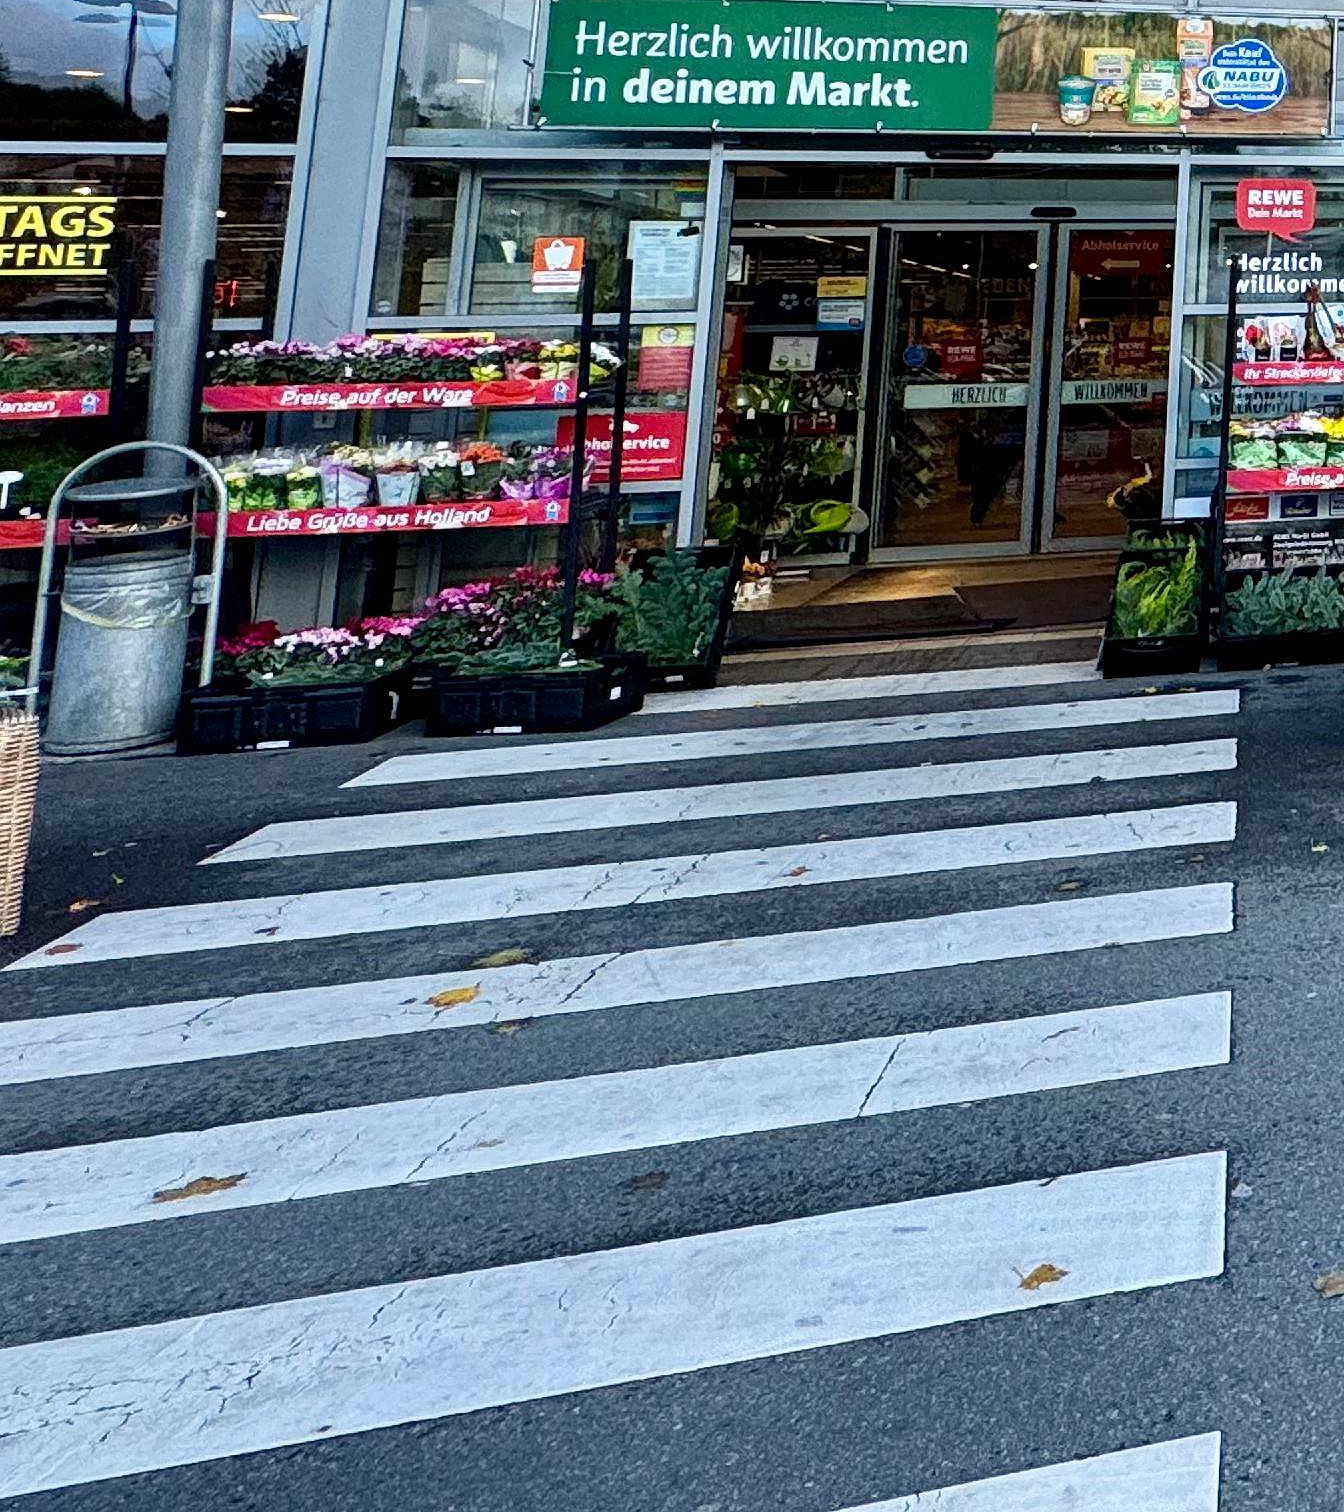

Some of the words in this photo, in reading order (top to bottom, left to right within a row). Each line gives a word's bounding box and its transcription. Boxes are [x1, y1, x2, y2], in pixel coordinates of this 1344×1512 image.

[575, 19, 733, 59] Herzlich
[746, 25, 969, 65] willkommen
[570, 67, 607, 102] in
[623, 68, 775, 106] deinem
[787, 71, 920, 108] Markt.
[1223, 71, 1275, 82] NABU
[1247, 189, 1305, 206] REWE
[0, 205, 116, 238] TAGS
[0, 242, 111, 266] FFNET
[1243, 366, 1263, 380] Ihr
[279, 389, 342, 406] Preise
[345, 387, 383, 405] auf
[384, 387, 418, 404] der
[422, 387, 474, 403] Ware
[952, 386, 1008, 405] HERZLICH
[1074, 382, 1148, 401] WILLKOMMEN
[1285, 471, 1331, 487] Preise
[246, 513, 302, 533] Liebe
[307, 511, 369, 531] Grüße
[373, 512, 409, 528] aus
[414, 506, 493, 526] Holland
